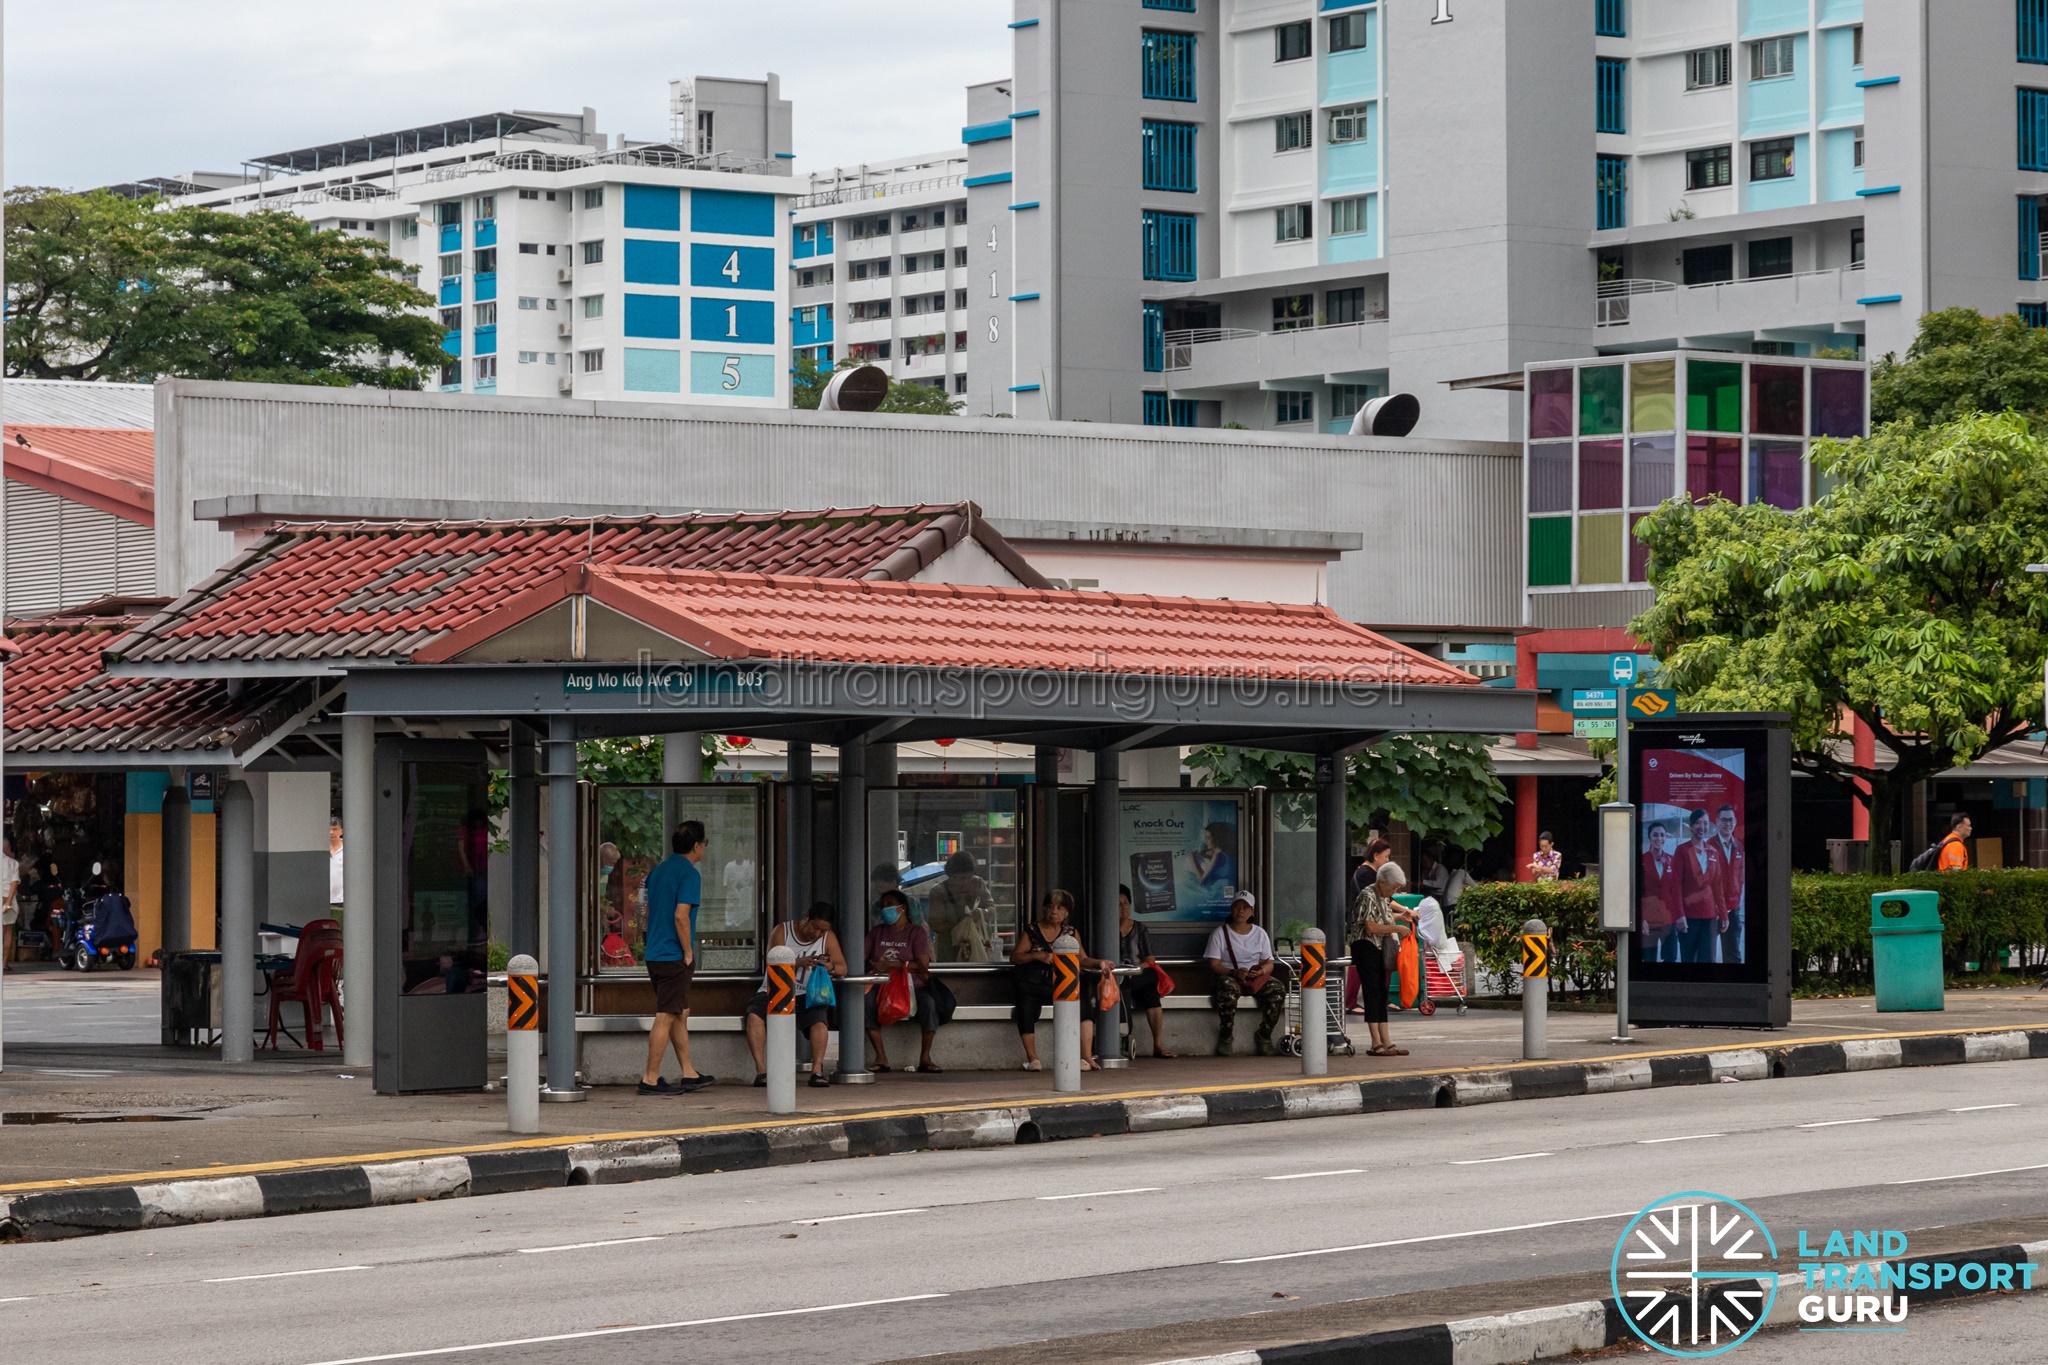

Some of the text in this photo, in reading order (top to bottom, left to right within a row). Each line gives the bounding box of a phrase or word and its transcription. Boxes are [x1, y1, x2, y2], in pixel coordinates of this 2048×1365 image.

[986, 225, 999, 343] 418
[721, 249, 741, 391] 415
[567, 671, 763, 690] Ang Mo Kio Ave 10 B03
[1585, 691, 1604, 699] 54371
[1122, 804, 1141, 812] LAC
[1133, 818, 1185, 829] Knock Out
